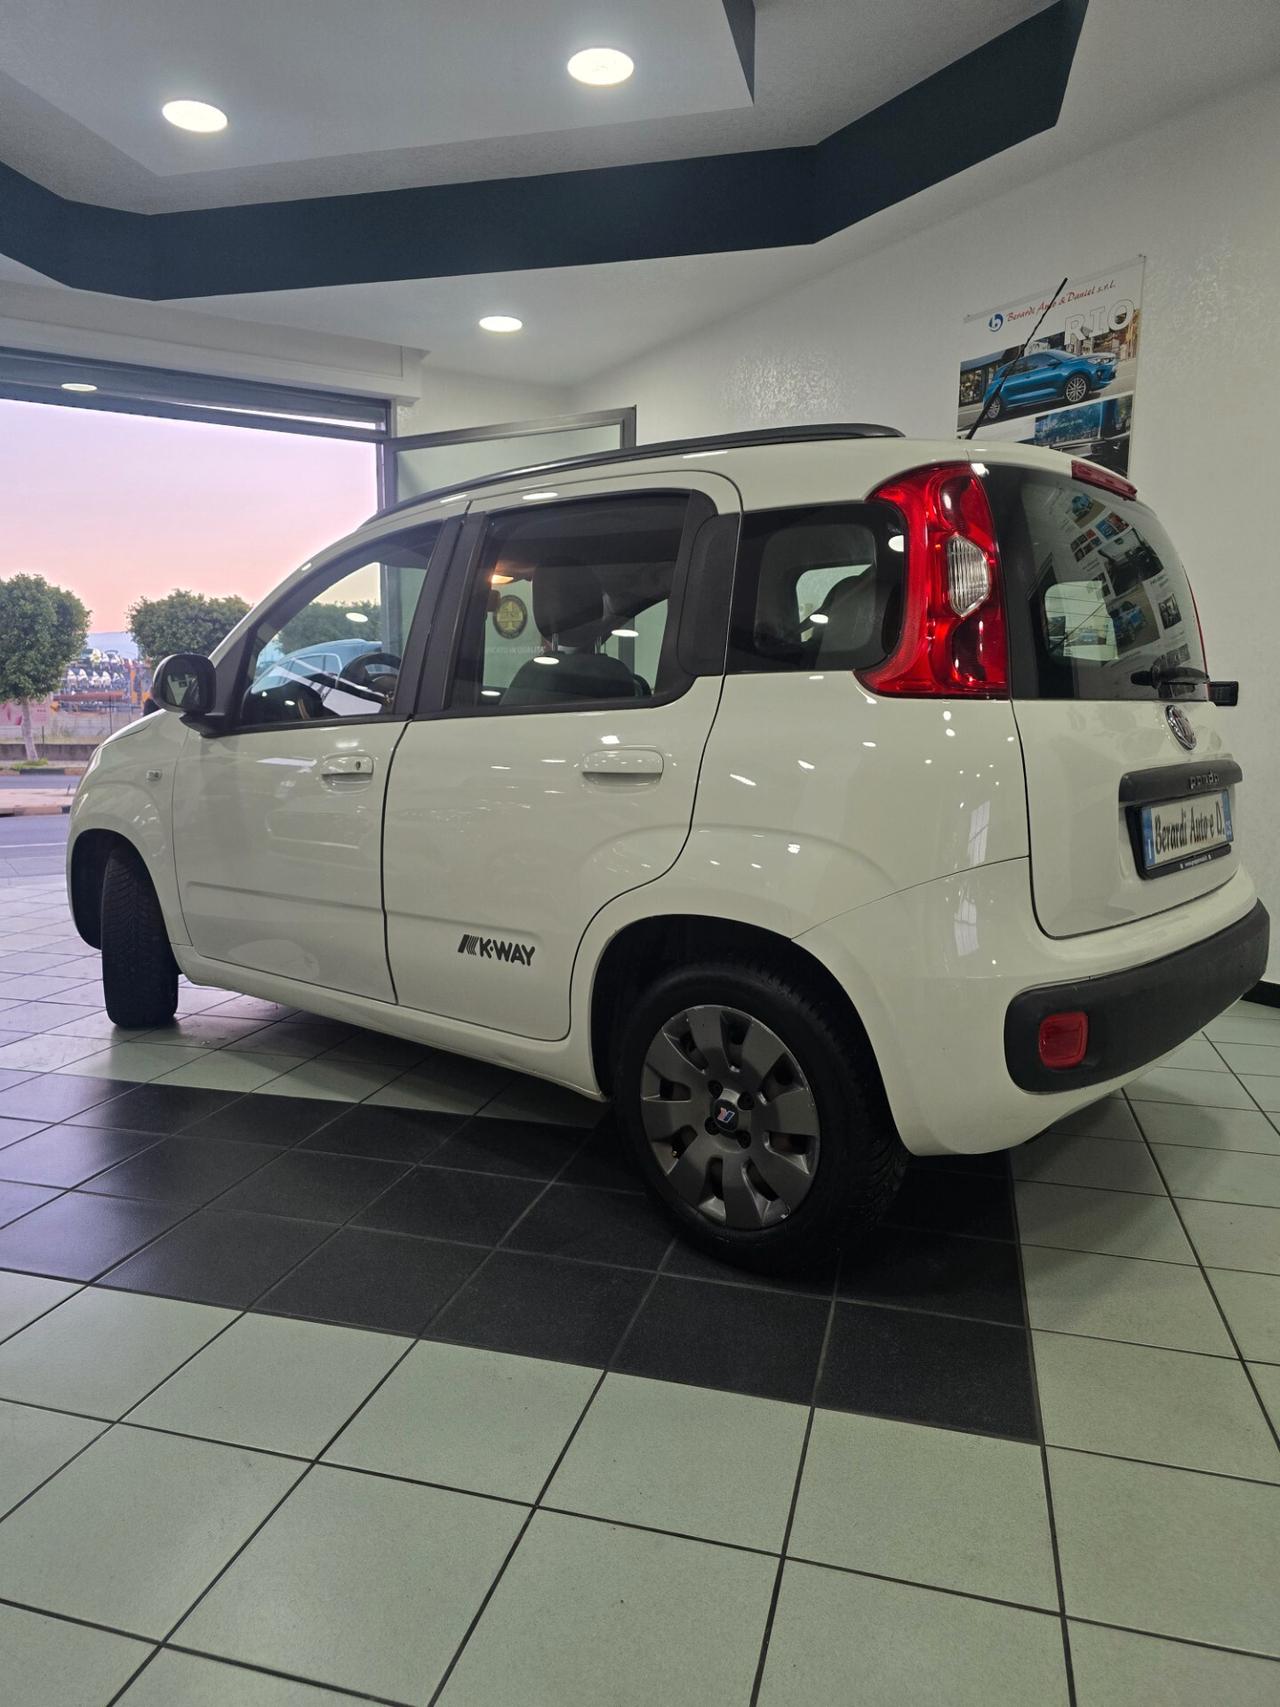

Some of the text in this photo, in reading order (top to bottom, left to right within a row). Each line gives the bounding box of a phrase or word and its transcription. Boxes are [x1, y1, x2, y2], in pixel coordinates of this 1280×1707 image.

[1064, 298, 1135, 346] RIO
[1154, 807, 1188, 855] Berardi
[1189, 806, 1208, 843] Auto
